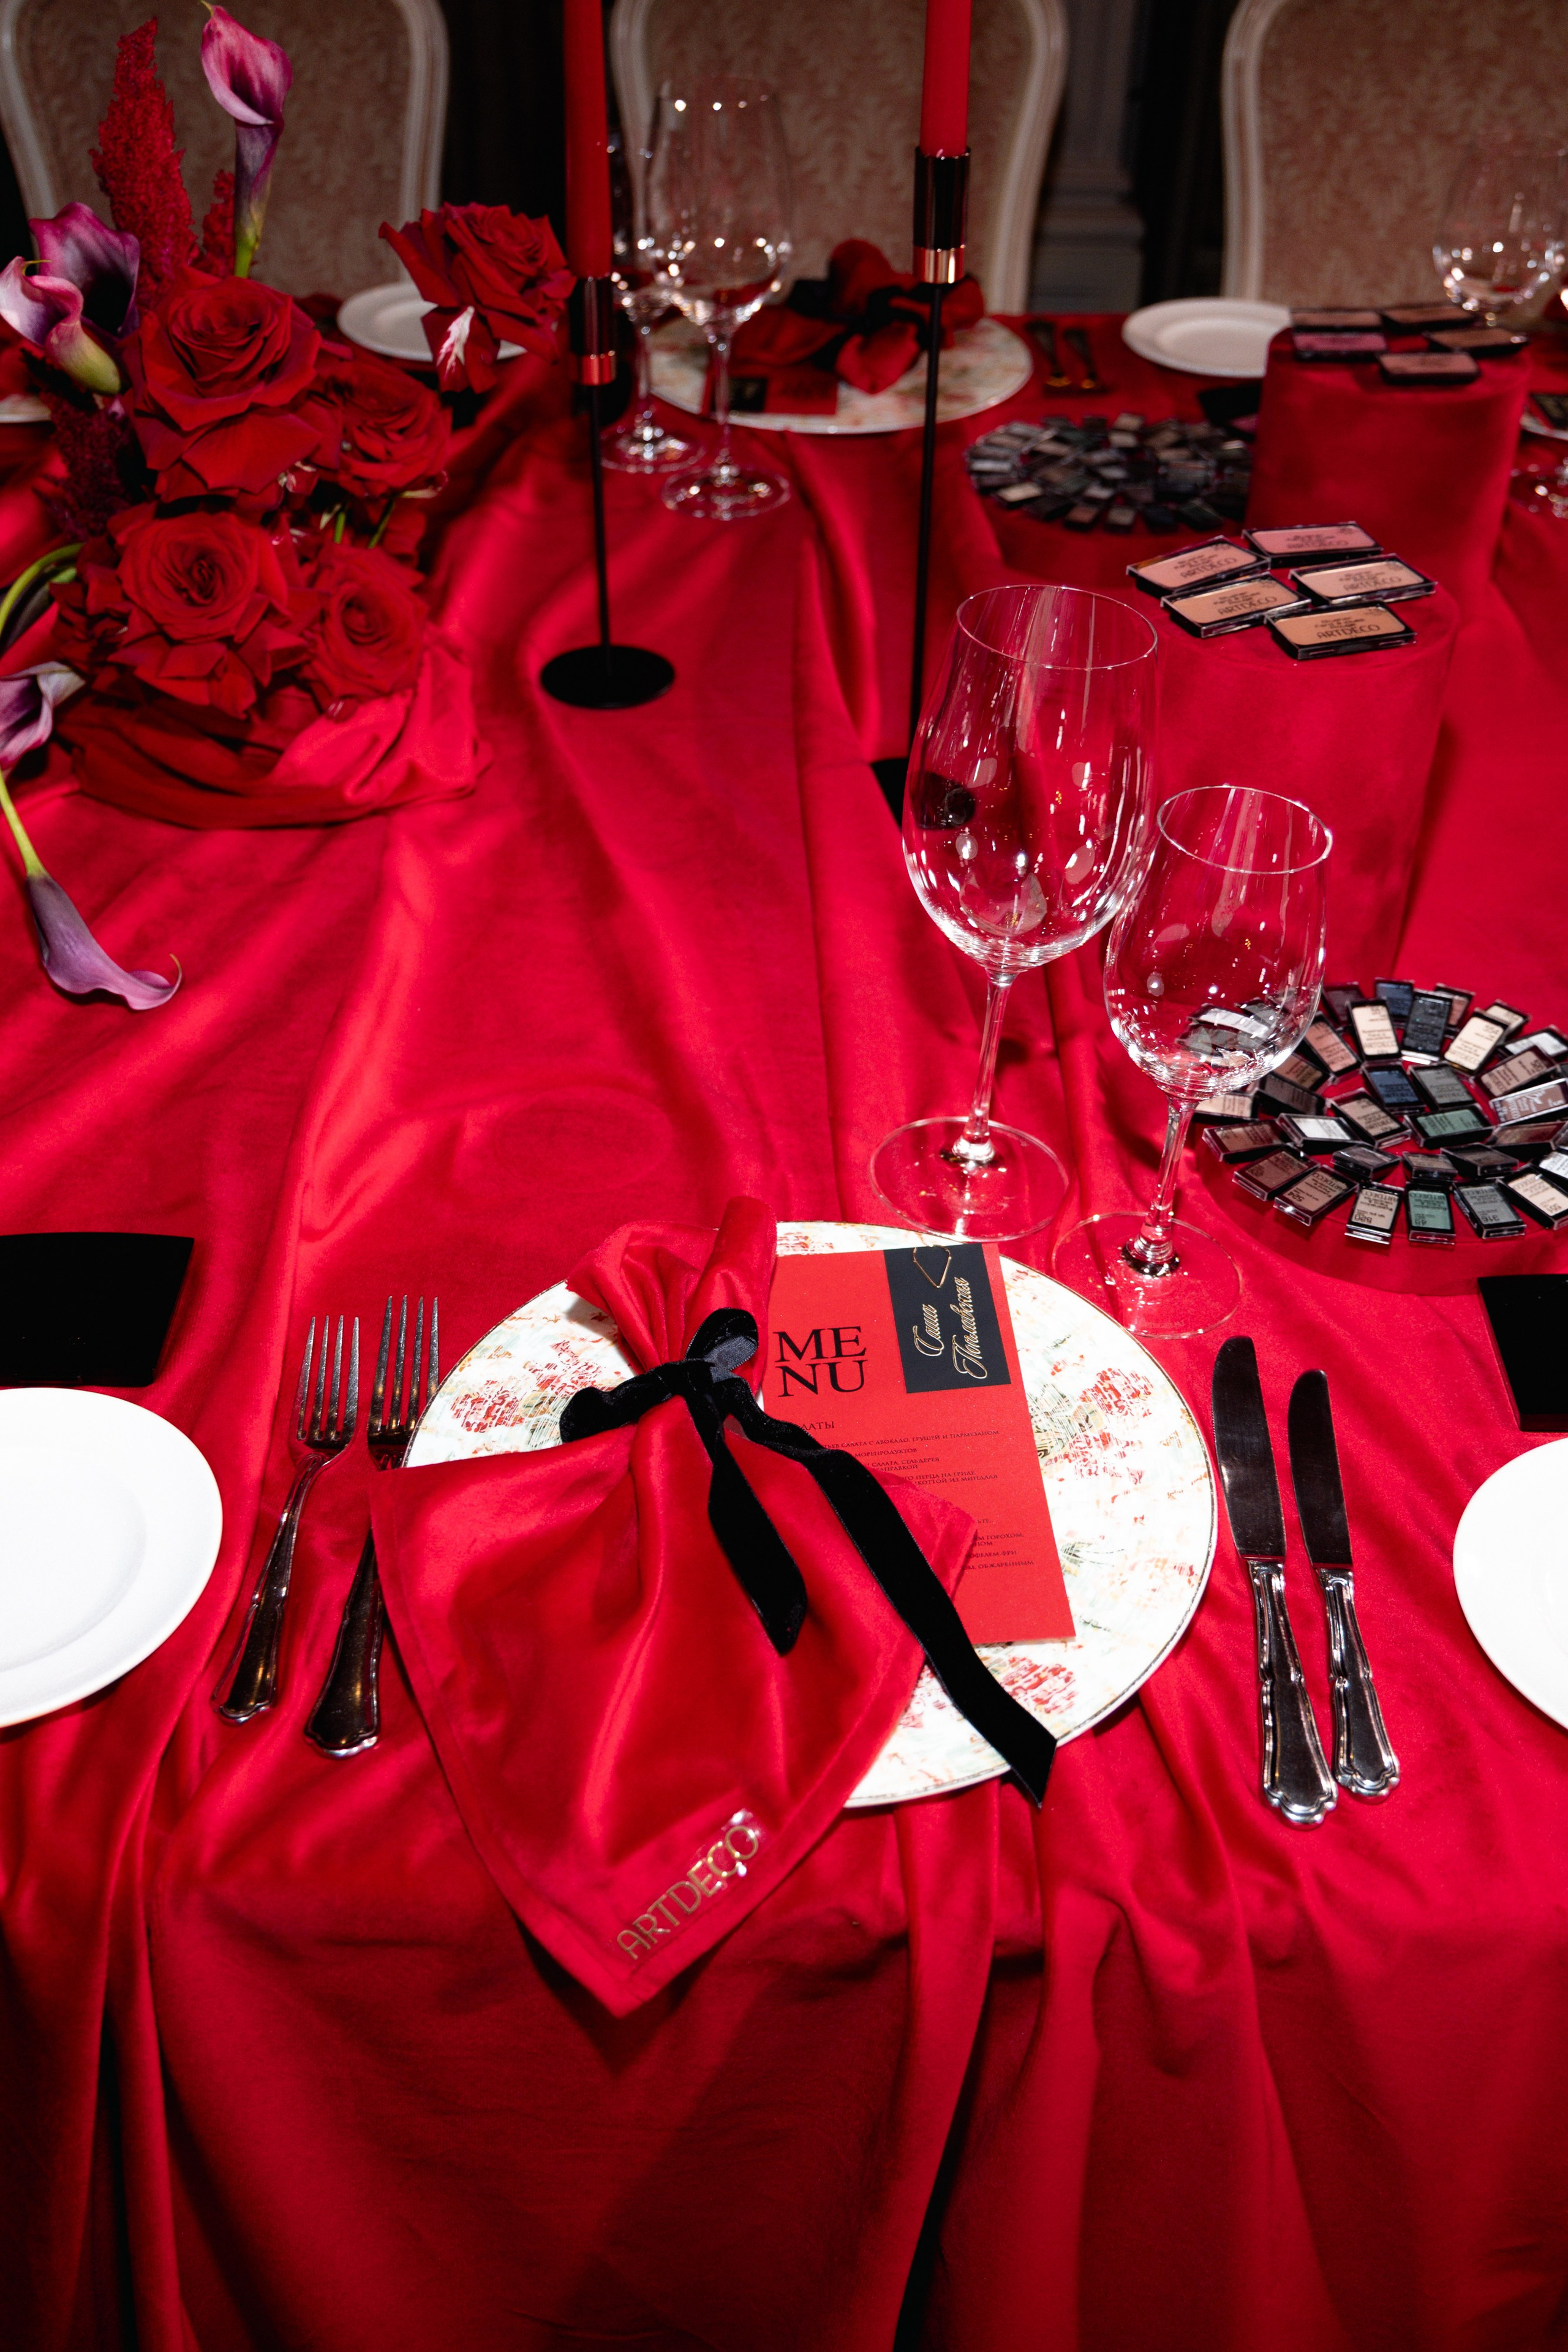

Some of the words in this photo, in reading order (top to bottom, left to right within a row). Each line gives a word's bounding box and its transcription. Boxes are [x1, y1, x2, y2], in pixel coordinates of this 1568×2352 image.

[1317, 624, 1381, 639] ARTDECO
[1313, 1172, 1343, 1191] ARTDECO
[1287, 1191, 1305, 1202] 524
[913, 1303, 944, 1357] Саша
[772, 1326, 867, 1362] ME
[775, 1359, 869, 1398] NU
[801, 1421, 835, 1431] ЛАТЫ
[950, 1430, 1000, 1439] ПАРМЕЗАНОМ
[855, 1448, 918, 1458] МОРЕПРОДУКТОВ
[901, 1457, 940, 1465] СЕЛЬДЕРЕЯ
[978, 1560, 1035, 1569] ОБЖАРЕННЫМ
[617, 1825, 760, 1961] ARTDECO
